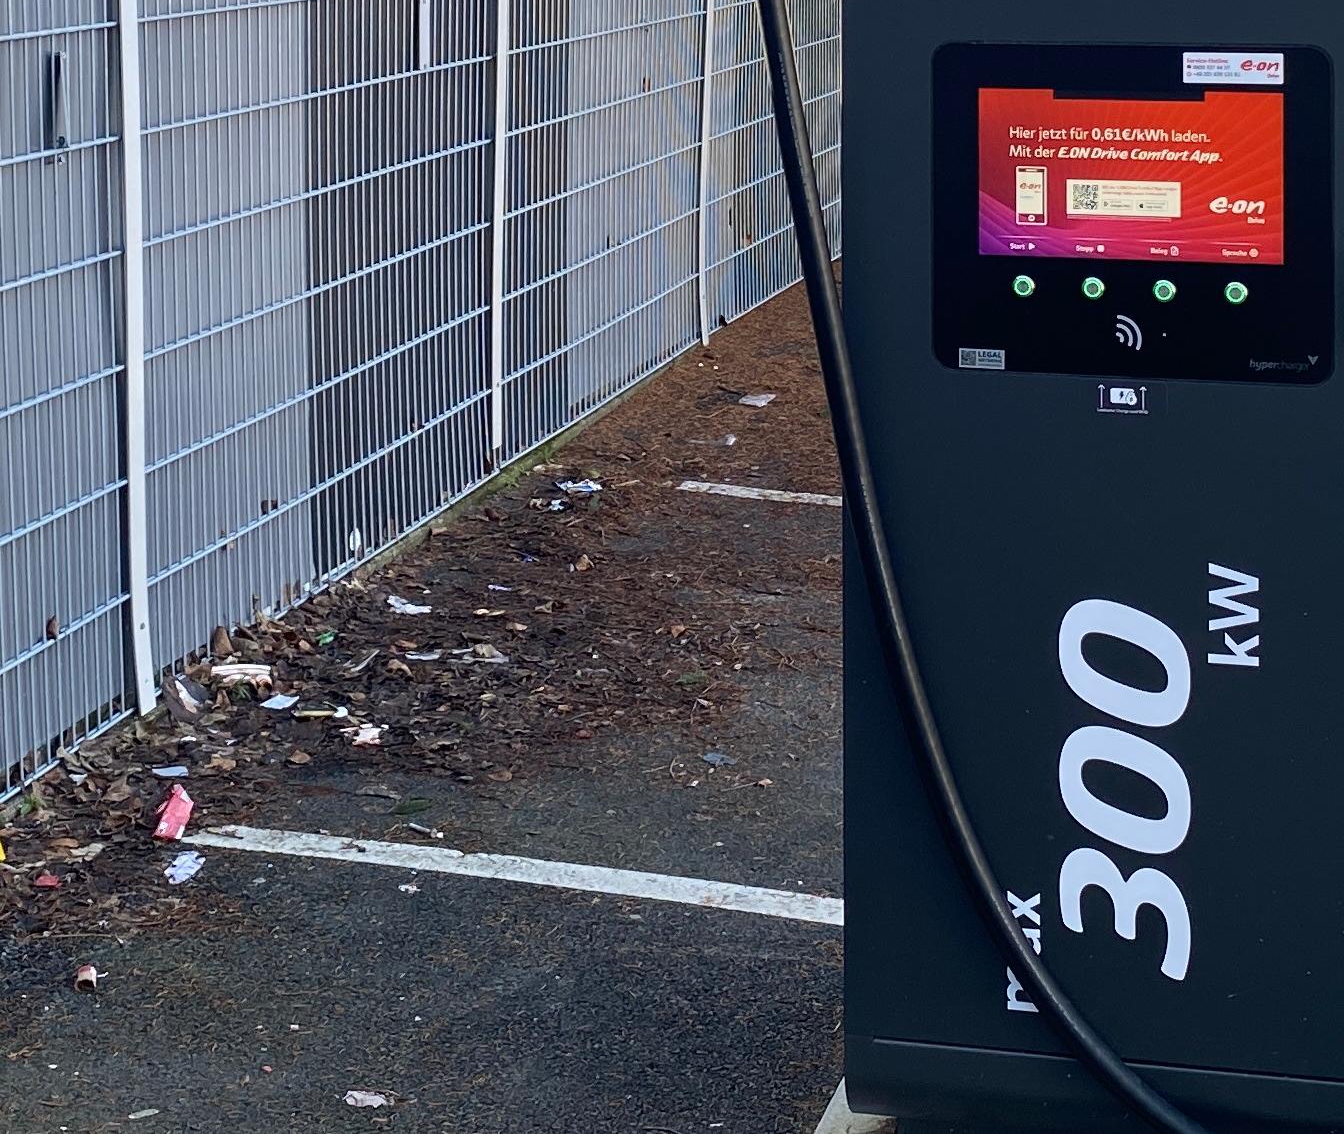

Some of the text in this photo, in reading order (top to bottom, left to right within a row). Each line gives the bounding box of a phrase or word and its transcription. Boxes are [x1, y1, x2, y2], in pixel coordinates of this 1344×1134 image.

[1009, 126, 1211, 143] Hier jetzt für 0,61€/kWh laden.
[1009, 144, 1032, 158] Mit
[1034, 145, 1056, 158] der
[1090, 147, 1128, 160] Drive
[1130, 148, 1190, 162] Comfort
[1189, 149, 1223, 164] App.
[1207, 562, 1260, 667] kW
[1058, 598, 1192, 981] 300
